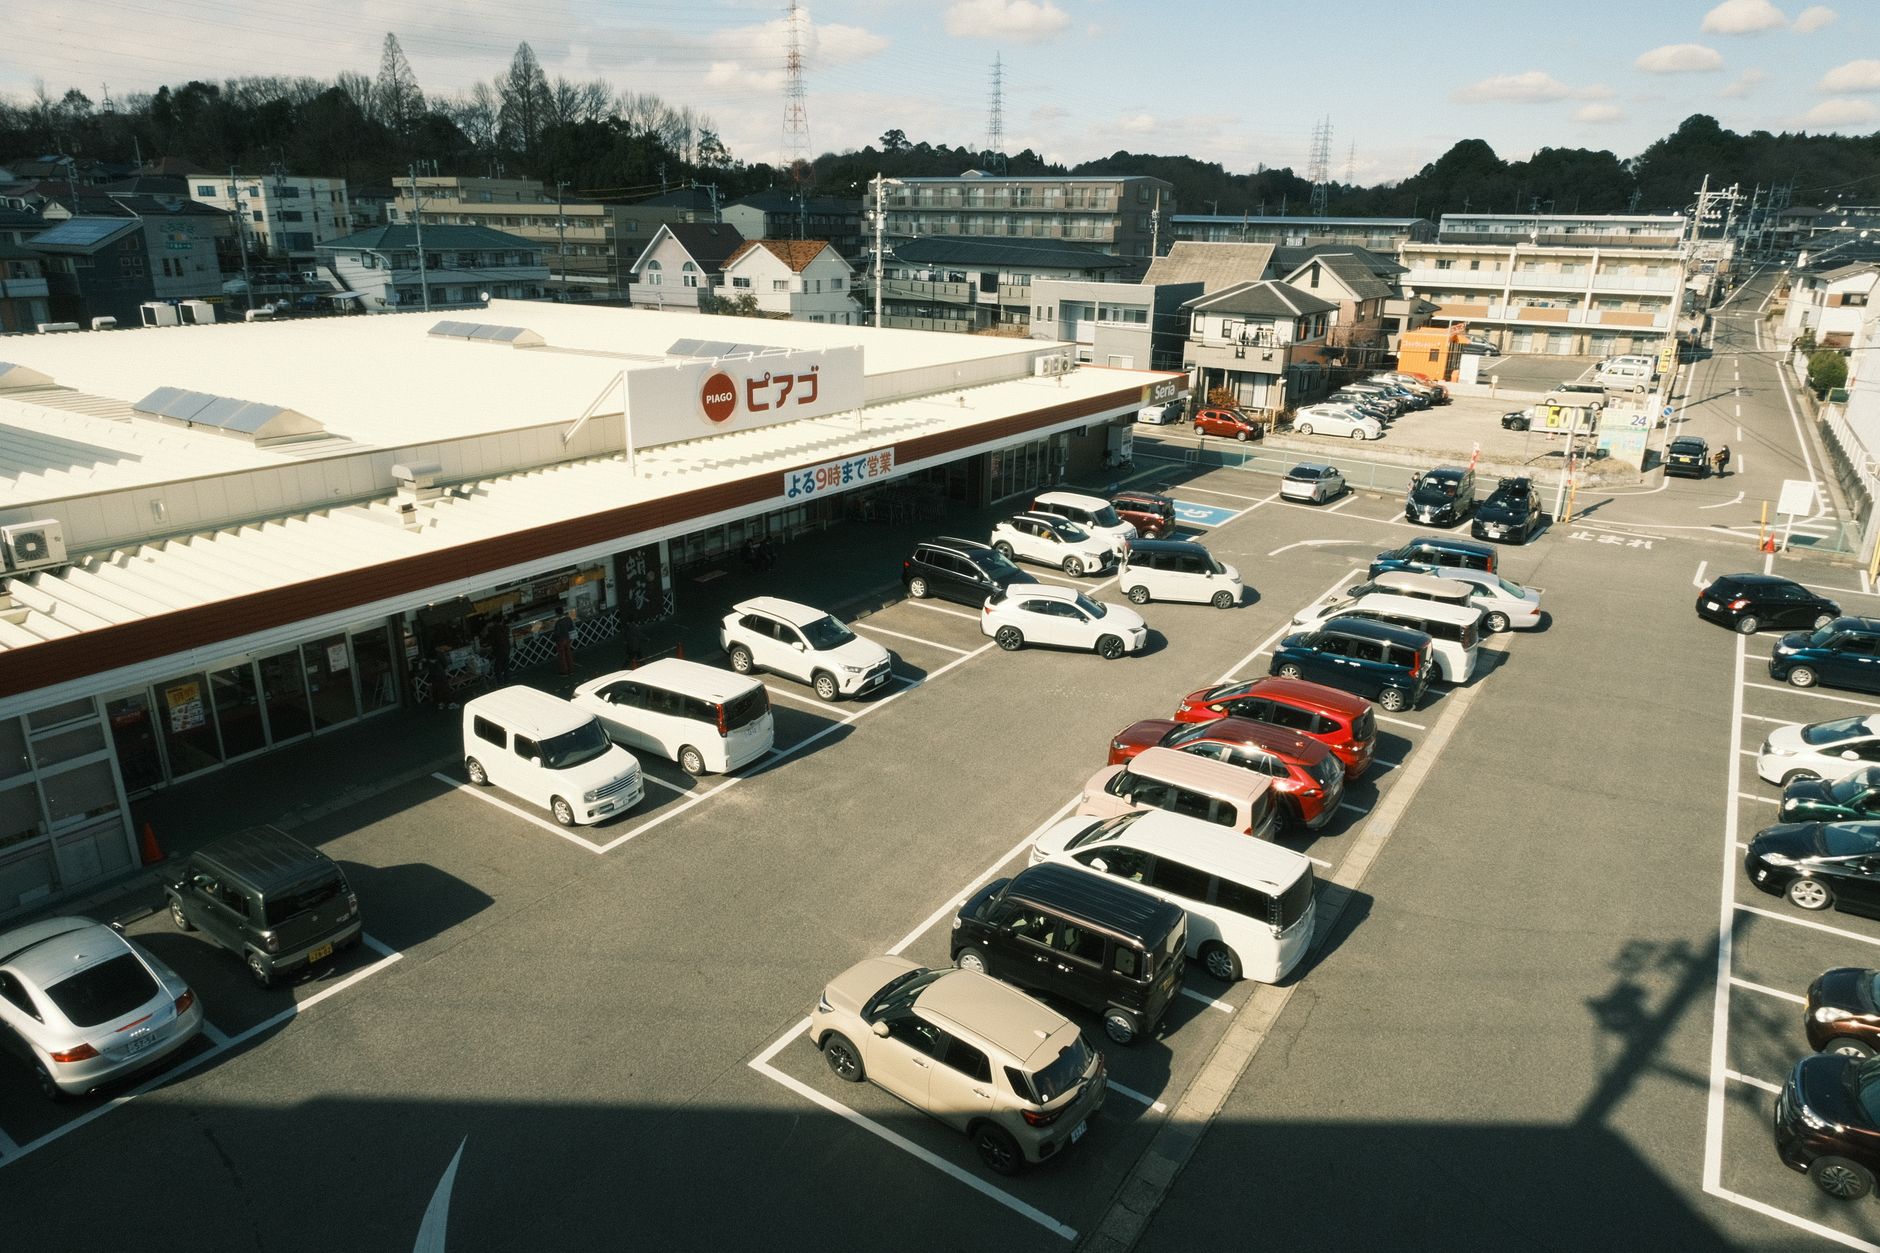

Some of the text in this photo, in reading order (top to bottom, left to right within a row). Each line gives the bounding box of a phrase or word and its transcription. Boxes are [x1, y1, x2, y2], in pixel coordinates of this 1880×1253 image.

[706, 391, 732, 404] PIAGO
[746, 365, 820, 412] ピアゴ
[1154, 381, 1175, 400] Seria
[1630, 414, 1648, 427] 24
[788, 451, 892, 498] よる9時まで営業
[1567, 531, 1654, 550] 止まれ
